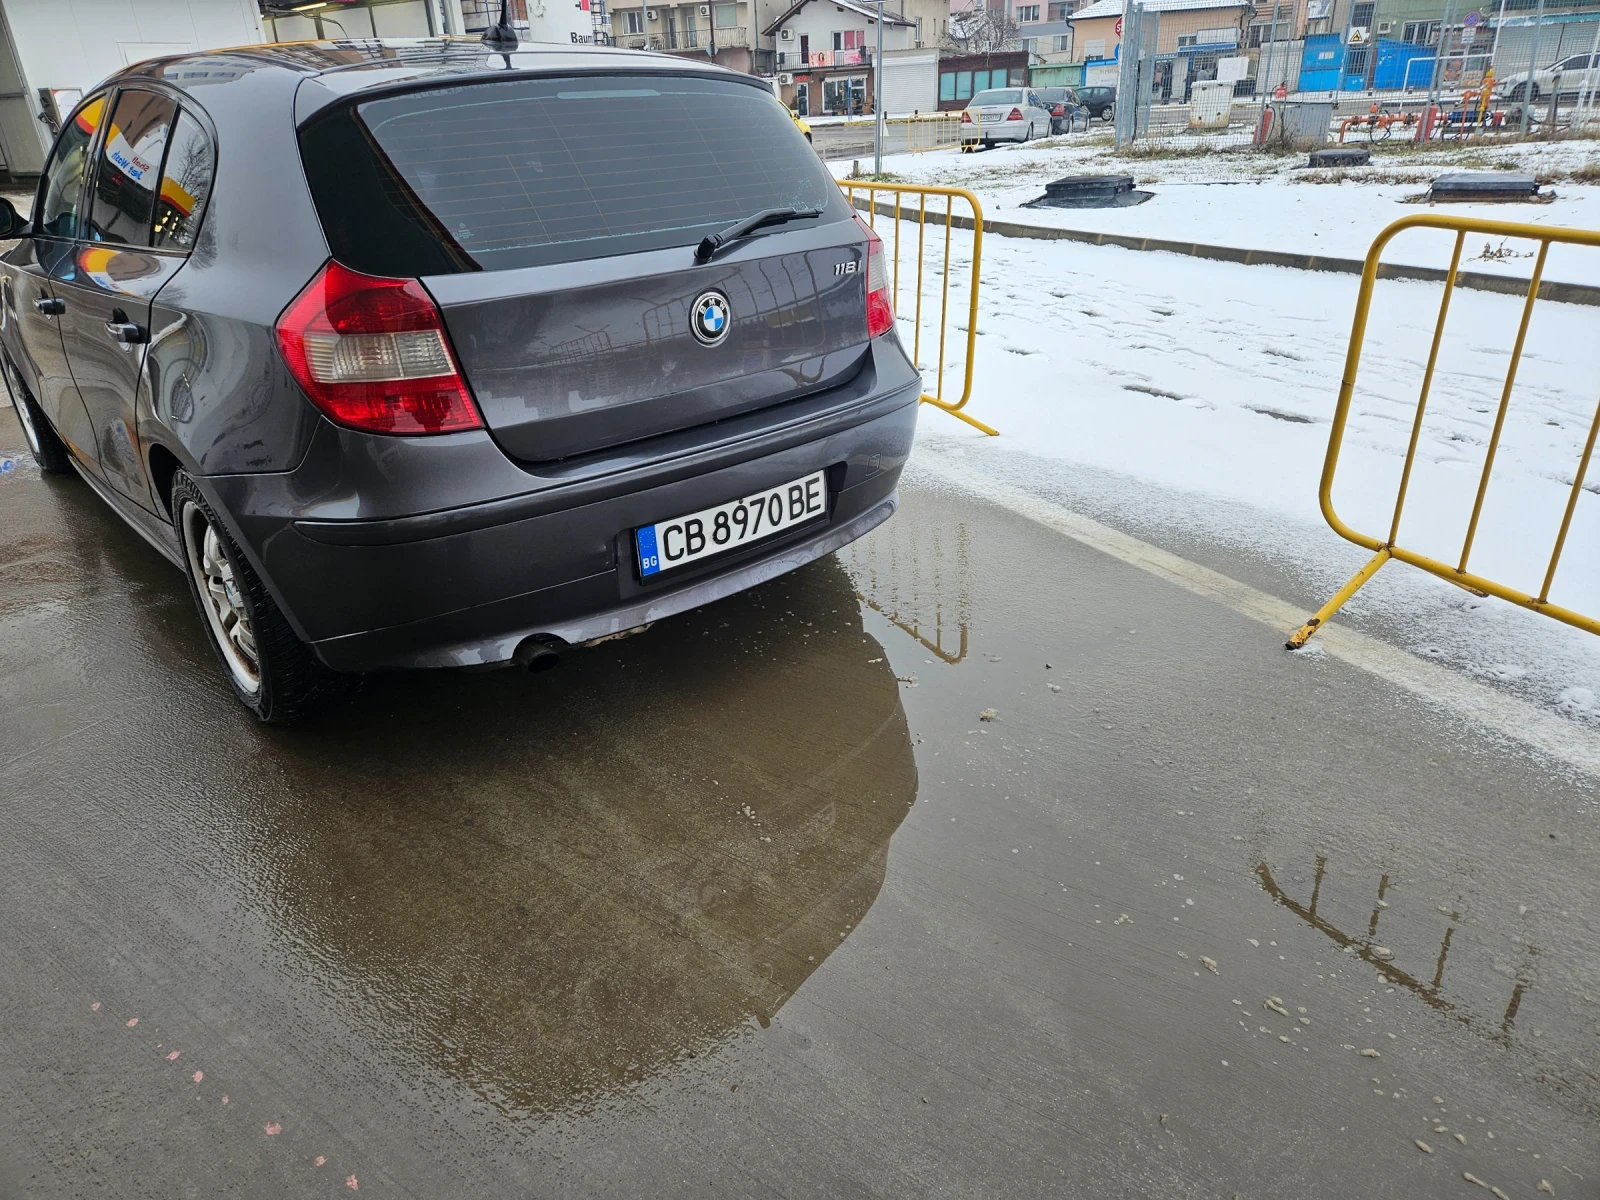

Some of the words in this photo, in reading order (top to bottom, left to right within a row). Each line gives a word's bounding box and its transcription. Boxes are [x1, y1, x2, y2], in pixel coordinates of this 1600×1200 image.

[663, 518, 706, 561] CB
[712, 492, 783, 545] 8970
[788, 476, 821, 521] BE
[642, 555, 658, 570] BG
